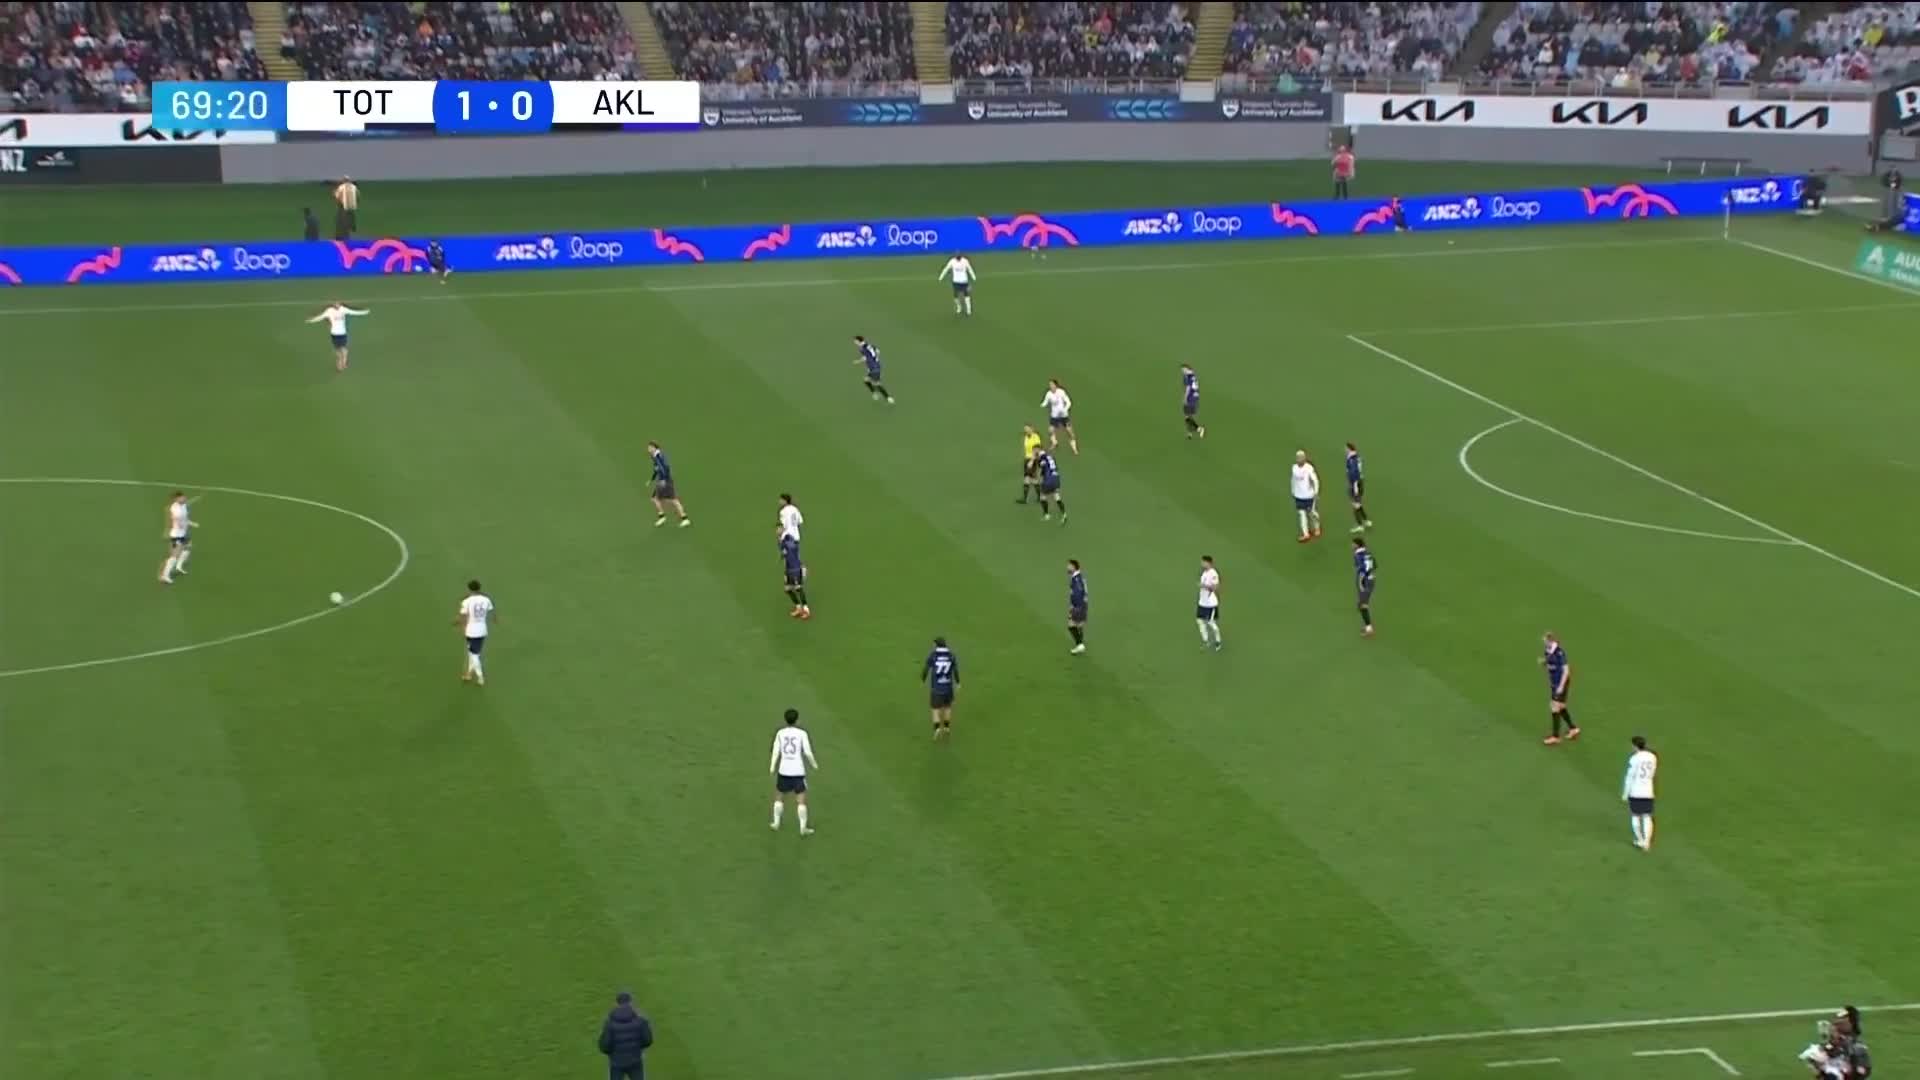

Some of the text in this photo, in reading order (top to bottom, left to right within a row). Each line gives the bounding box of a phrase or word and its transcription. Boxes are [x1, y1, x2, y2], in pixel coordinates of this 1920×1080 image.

[1382, 98, 1475, 122] KIA
[1552, 101, 1648, 125] KIA
[1727, 104, 1829, 129] KIA
[1423, 196, 1541, 221] ANZ loop
[1124, 211, 1242, 236] ANZ loop
[495, 236, 624, 262] ANZ loop
[816, 224, 938, 249] ANZ loop
[152, 247, 291, 274] ANZ loop
[935, 661, 952, 674] 77
[783, 736, 797, 755] 25
